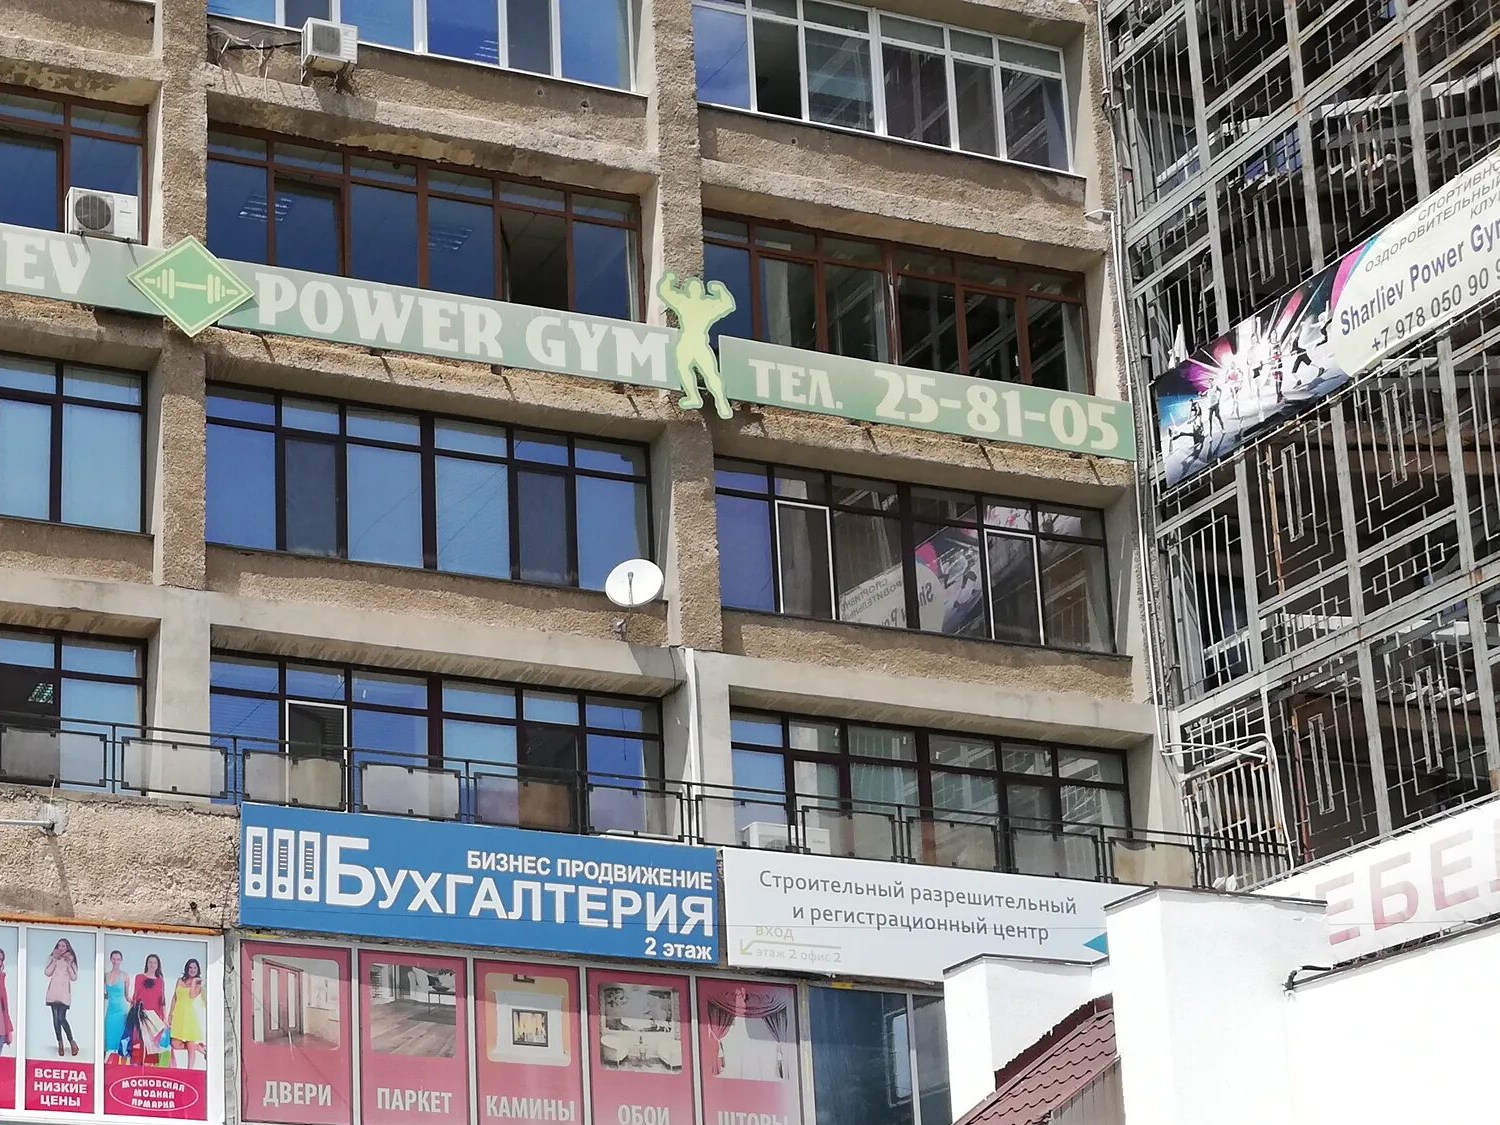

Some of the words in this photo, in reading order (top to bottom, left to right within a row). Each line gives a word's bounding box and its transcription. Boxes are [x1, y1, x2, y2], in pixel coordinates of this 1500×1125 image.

[1341, 279, 1404, 336] Sharliev
[1410, 241, 1464, 292] Power
[1372, 326, 1389, 351] +7
[1396, 307, 1425, 339] 978
[1431, 284, 1462, 318] 050
[1468, 268, 1489, 296] 90
[255, 272, 503, 358] POWER
[525, 316, 670, 382] GYM
[748, 358, 843, 408] ТЕЛ.
[874, 370, 1118, 450] 25-81-05
[326, 836, 713, 936] БУХГАЛТЕРИЯ
[468, 851, 551, 875] БИЗНЕС
[556, 857, 712, 890] ПРОДВИЖЕНИЕ
[759, 870, 904, 899] Строительный
[910, 885, 1077, 915] разрешительный
[793, 907, 804, 919] и
[810, 907, 987, 935] регистрационный
[993, 922, 1049, 943] центр
[644, 936, 657, 955] 2
[663, 940, 711, 960] этаж
[789, 949, 796, 959] 2
[834, 953, 841, 962] 2
[34, 1068, 87, 1082] ВСЕГДА
[34, 1082, 87, 1094] НИЗКИЕ
[40, 1095, 80, 1107] ЦЕНЫ
[263, 1082, 332, 1108] ДВЕРИ
[376, 1087, 452, 1115] ПАРКЕТ
[486, 1095, 576, 1122] КАМИНЫ
